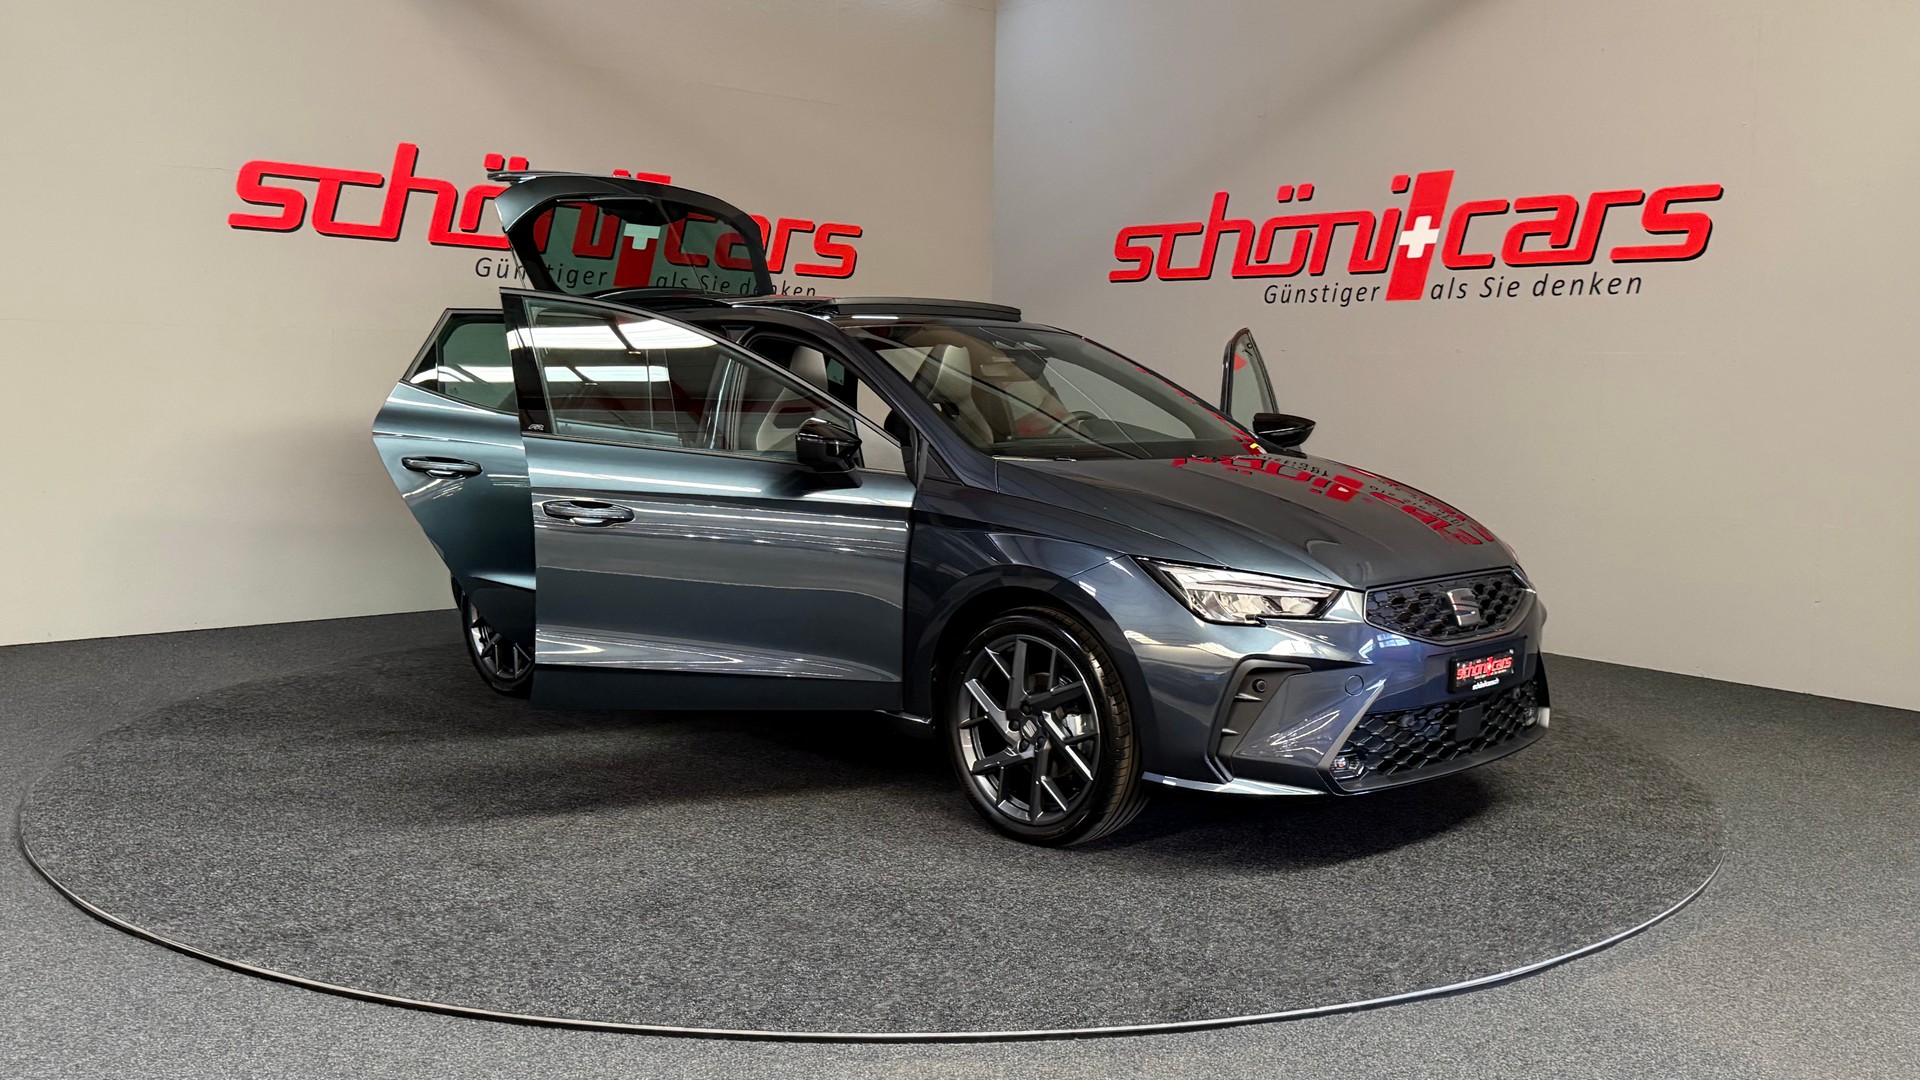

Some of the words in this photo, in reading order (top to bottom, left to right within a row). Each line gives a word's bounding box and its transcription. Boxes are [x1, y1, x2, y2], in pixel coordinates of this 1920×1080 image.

[664, 213, 863, 280] cars
[1108, 174, 1411, 283] schöni
[1441, 183, 1724, 271] cars
[474, 256, 609, 288] Güntiger
[655, 271, 689, 290] als
[700, 274, 731, 293] Sie
[1263, 282, 1381, 308] Günstiger
[1430, 277, 1468, 300] als
[1479, 275, 1521, 299] Sie
[1532, 271, 1643, 298] denken
